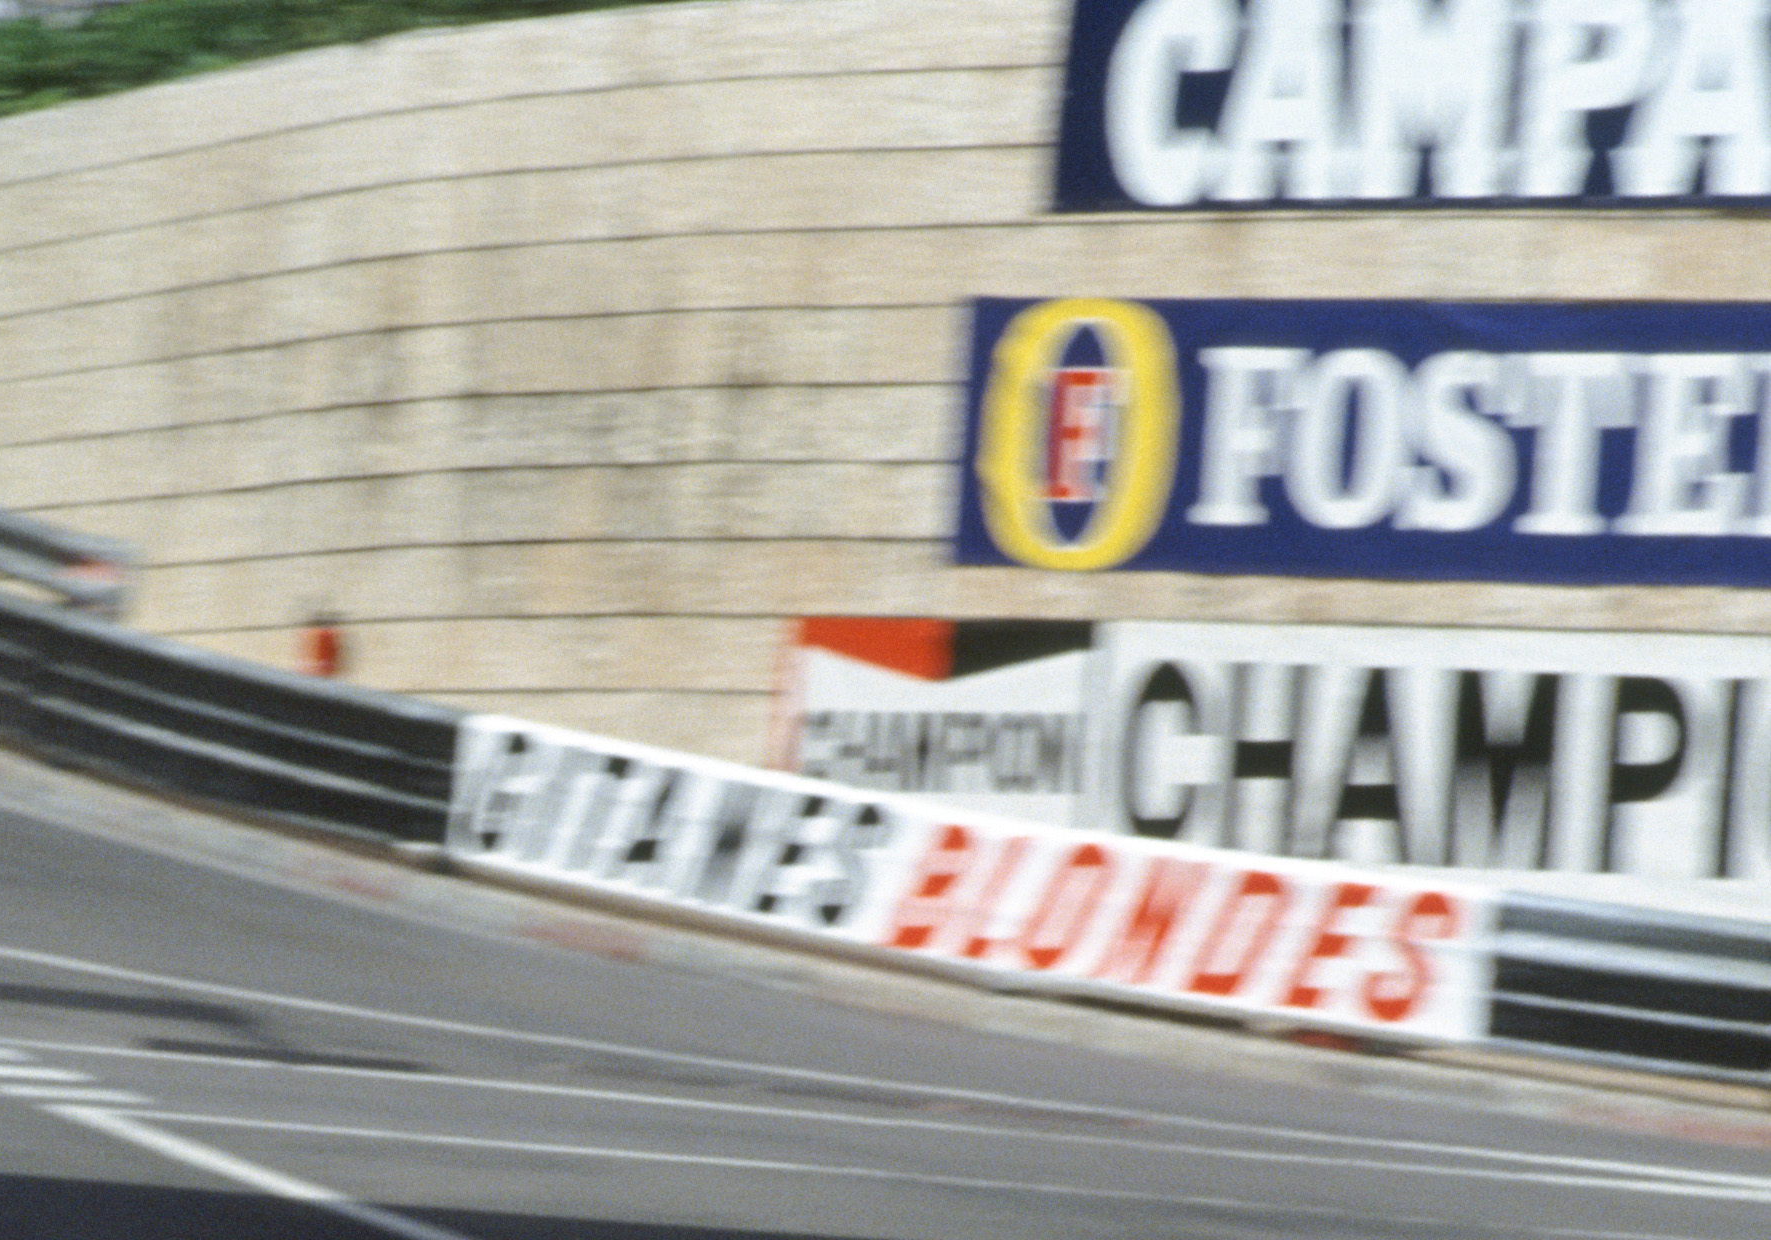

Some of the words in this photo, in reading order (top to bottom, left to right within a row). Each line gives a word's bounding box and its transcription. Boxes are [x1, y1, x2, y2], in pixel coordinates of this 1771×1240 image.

[1185, 346, 1771, 536] FOSTE
[1121, 660, 1771, 880] CHAMPI
[887, 824, 1460, 1021] BLONDES
